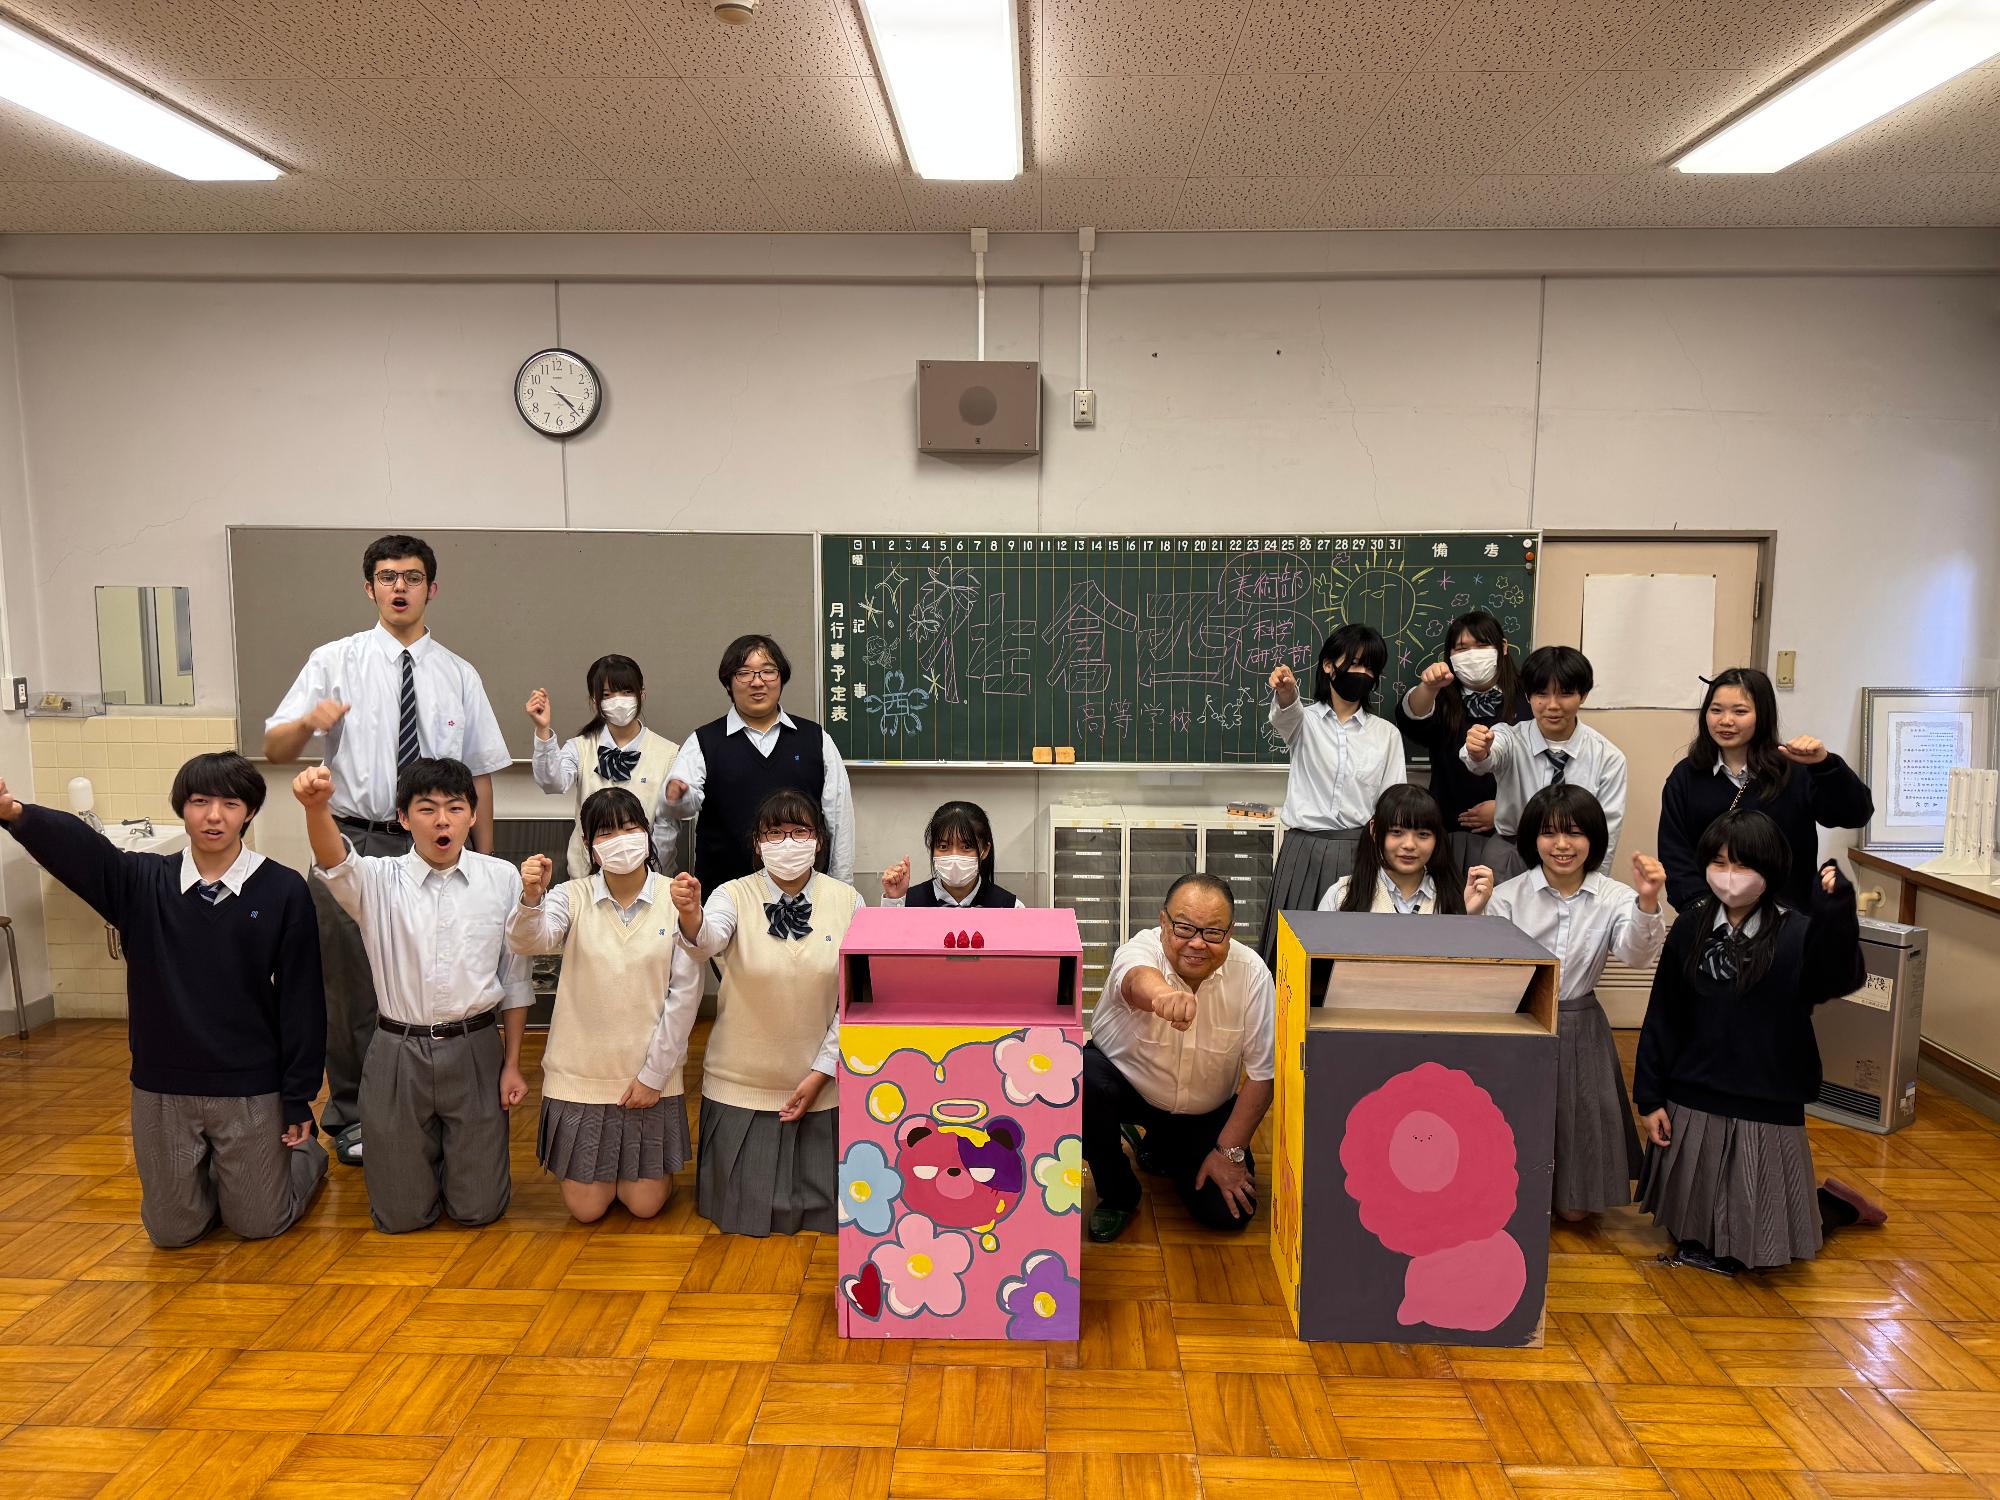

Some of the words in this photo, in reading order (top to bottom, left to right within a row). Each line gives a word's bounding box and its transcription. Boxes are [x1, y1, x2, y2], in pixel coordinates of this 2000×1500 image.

[540, 364, 549, 375] 11
[553, 361, 562, 371] 12
[531, 374, 541, 385] 10
[578, 375, 584, 384] 2
[527, 388, 534, 399] 9
[583, 388, 589, 399] 3
[532, 403, 539, 413] 8
[578, 403, 584, 413] 4
[544, 412, 550, 423] 7
[556, 415, 563, 426] 6
[569, 412, 576, 423] 5
[853, 540, 863, 550] 日
[871, 540, 876, 550] 1
[888, 540, 895, 550] 2
[906, 540, 912, 550] 3
[921, 540, 930, 550] 4
[940, 540, 947, 550] 5
[956, 540, 964, 550] 6
[973, 540, 981, 550] 7
[990, 540, 998, 550] 8
[1007, 540, 1015, 550] 9
[1023, 540, 1033, 550] 10
[1040, 541, 1050, 551] 11
[1057, 541, 1067, 551] 12
[1074, 541, 1085, 551] 13
[1091, 541, 1102, 551] 14
[1108, 541, 1119, 551] 15
[1126, 541, 1136, 551] 16
[1143, 541, 1154, 551] 17
[1160, 541, 1171, 551] 18
[1177, 541, 1188, 551] 19
[1194, 541, 1207, 551] 20
[1211, 539, 1223, 551] 21
[1229, 539, 1242, 551] 22
[1246, 539, 1259, 551] 23
[1264, 539, 1277, 551] 24
[1281, 539, 1294, 551] 25
[1300, 539, 1312, 551] 26
[1317, 539, 1330, 551] 27
[1335, 539, 1348, 551] 28
[1352, 539, 1366, 551] 29
[1370, 539, 1384, 551] 30
[1389, 539, 1401, 551] 31
[851, 554, 863, 566] 曜
[1229, 562, 1303, 599] 美術部
[1252, 617, 1294, 640] 科学
[1245, 640, 1312, 669] 研究部
[829, 602, 848, 722] 月行事予定表
[1076, 699, 1192, 739] 高等学校
